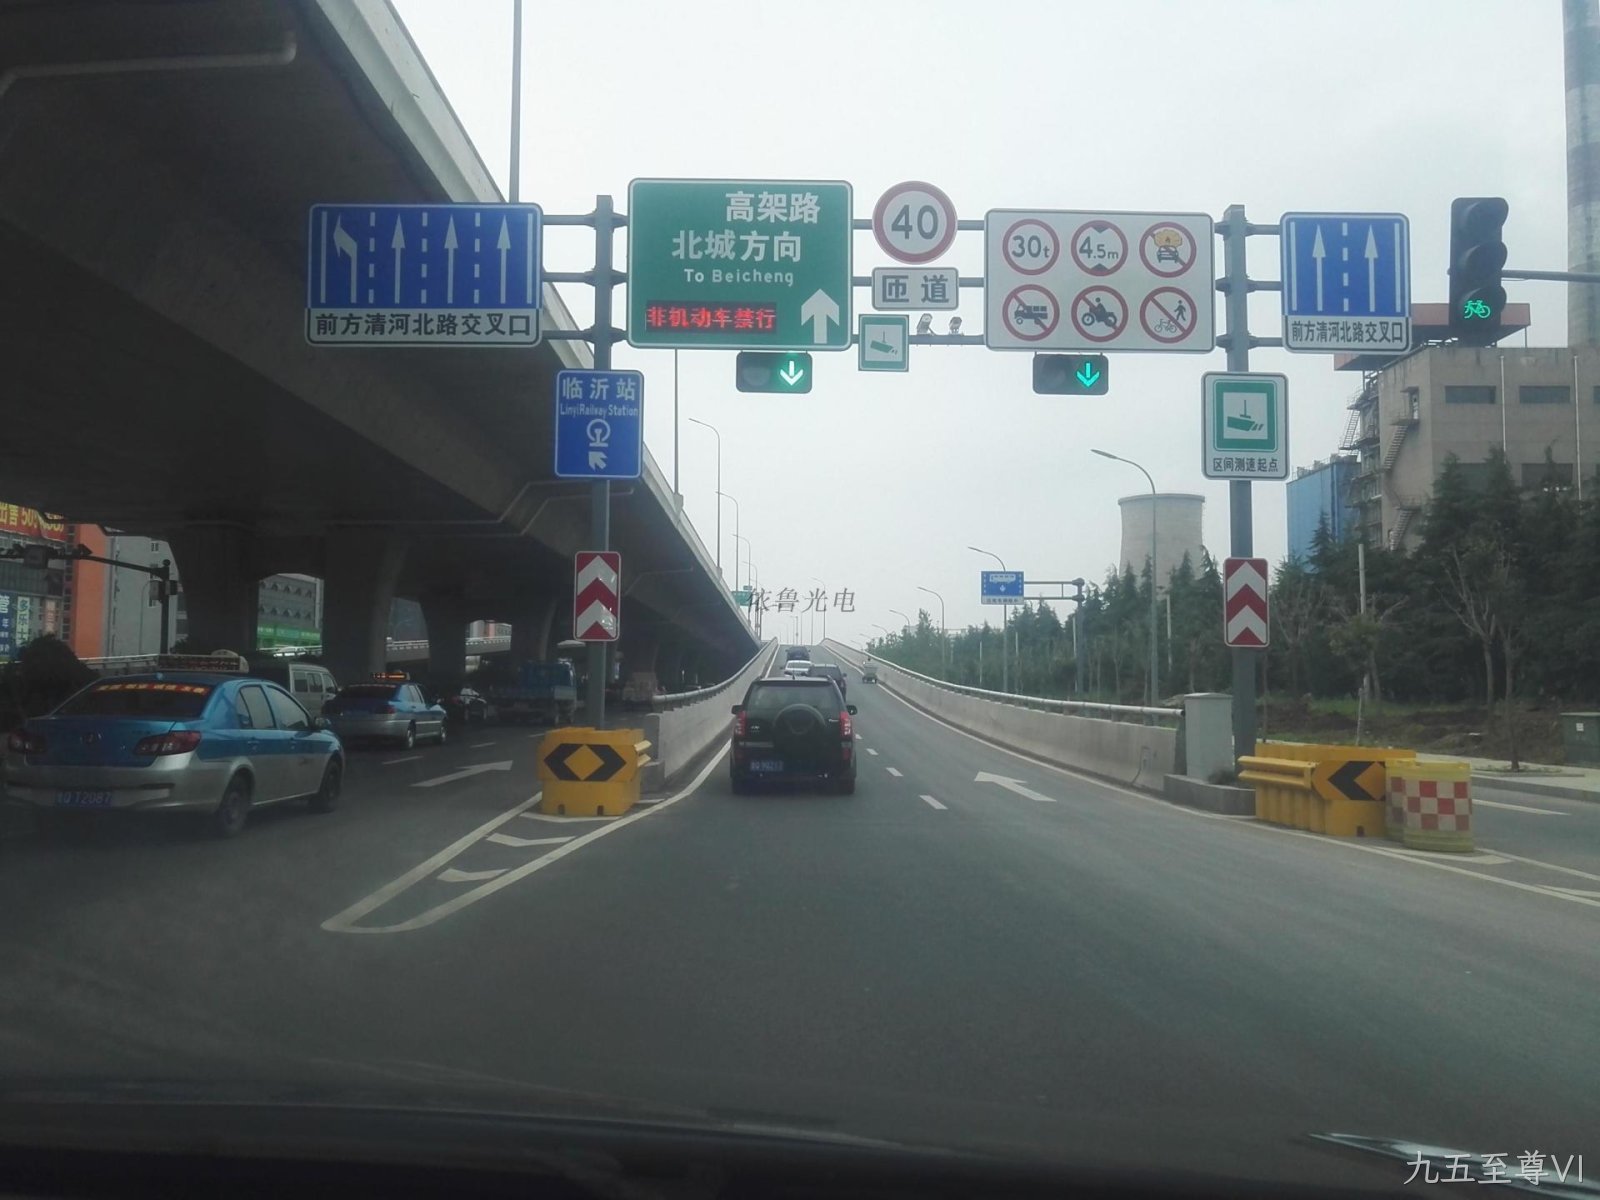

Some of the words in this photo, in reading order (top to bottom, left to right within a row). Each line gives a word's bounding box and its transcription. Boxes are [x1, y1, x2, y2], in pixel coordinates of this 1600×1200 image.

[725, 190, 820, 224] 高架路
[890, 204, 939, 240] 40
[671, 229, 802, 262] 北城方向
[1011, 234, 1050, 259] 30t
[1079, 236, 1119, 260] 4.5m
[684, 268, 705, 283] To
[712, 268, 794, 287] Beicheng
[881, 274, 949, 304] 匝道
[315, 312, 531, 336] 前方清河北路交叉口
[647, 306, 776, 329] 非机动车禁行
[1291, 320, 1403, 343] 前方清河北路交叉口
[562, 376, 637, 401] 临沂站
[608, 403, 638, 416] Station
[1212, 456, 1278, 472] 区间测速起点
